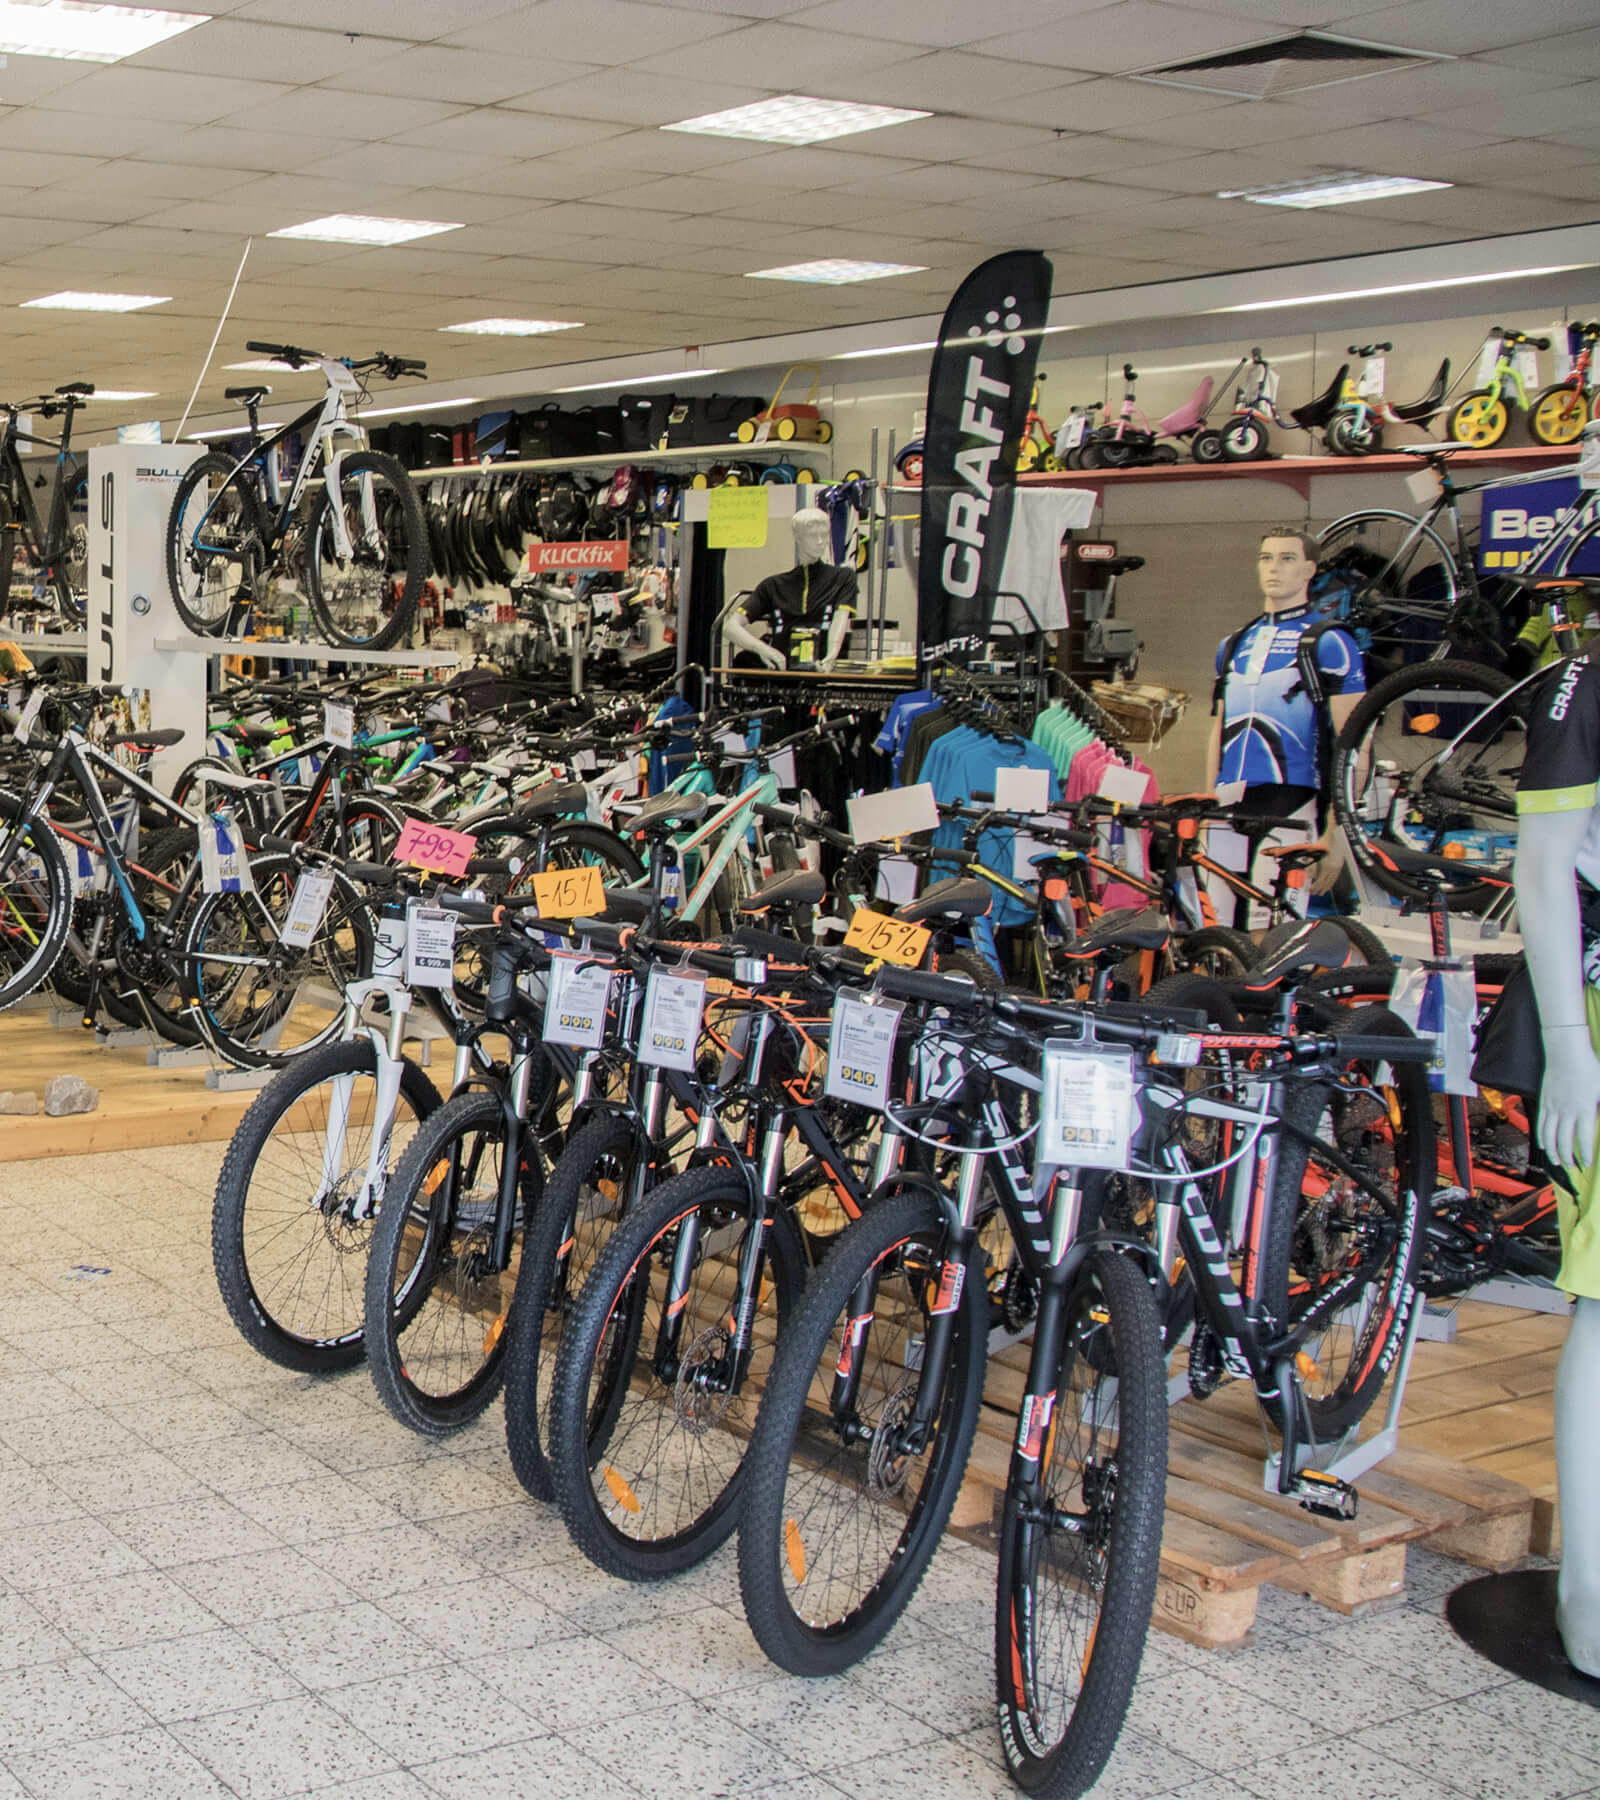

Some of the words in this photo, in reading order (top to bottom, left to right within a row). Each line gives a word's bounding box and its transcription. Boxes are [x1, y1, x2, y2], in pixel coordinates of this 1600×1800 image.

[135, 468, 186, 477] BULL
[941, 355, 1011, 600] CRAFT
[101, 471, 114, 683] ULLS
[538, 548, 614, 566] KLICKfix
[921, 635, 969, 662] CRAFT
[1548, 662, 1585, 721] CRAFT
[852, 920, 917, 957] -15%
[1162, 1145, 1243, 1306] SCOTT
[1378, 1283, 1416, 1373] MAXXIS
[1163, 1590, 1198, 1615] EUR
